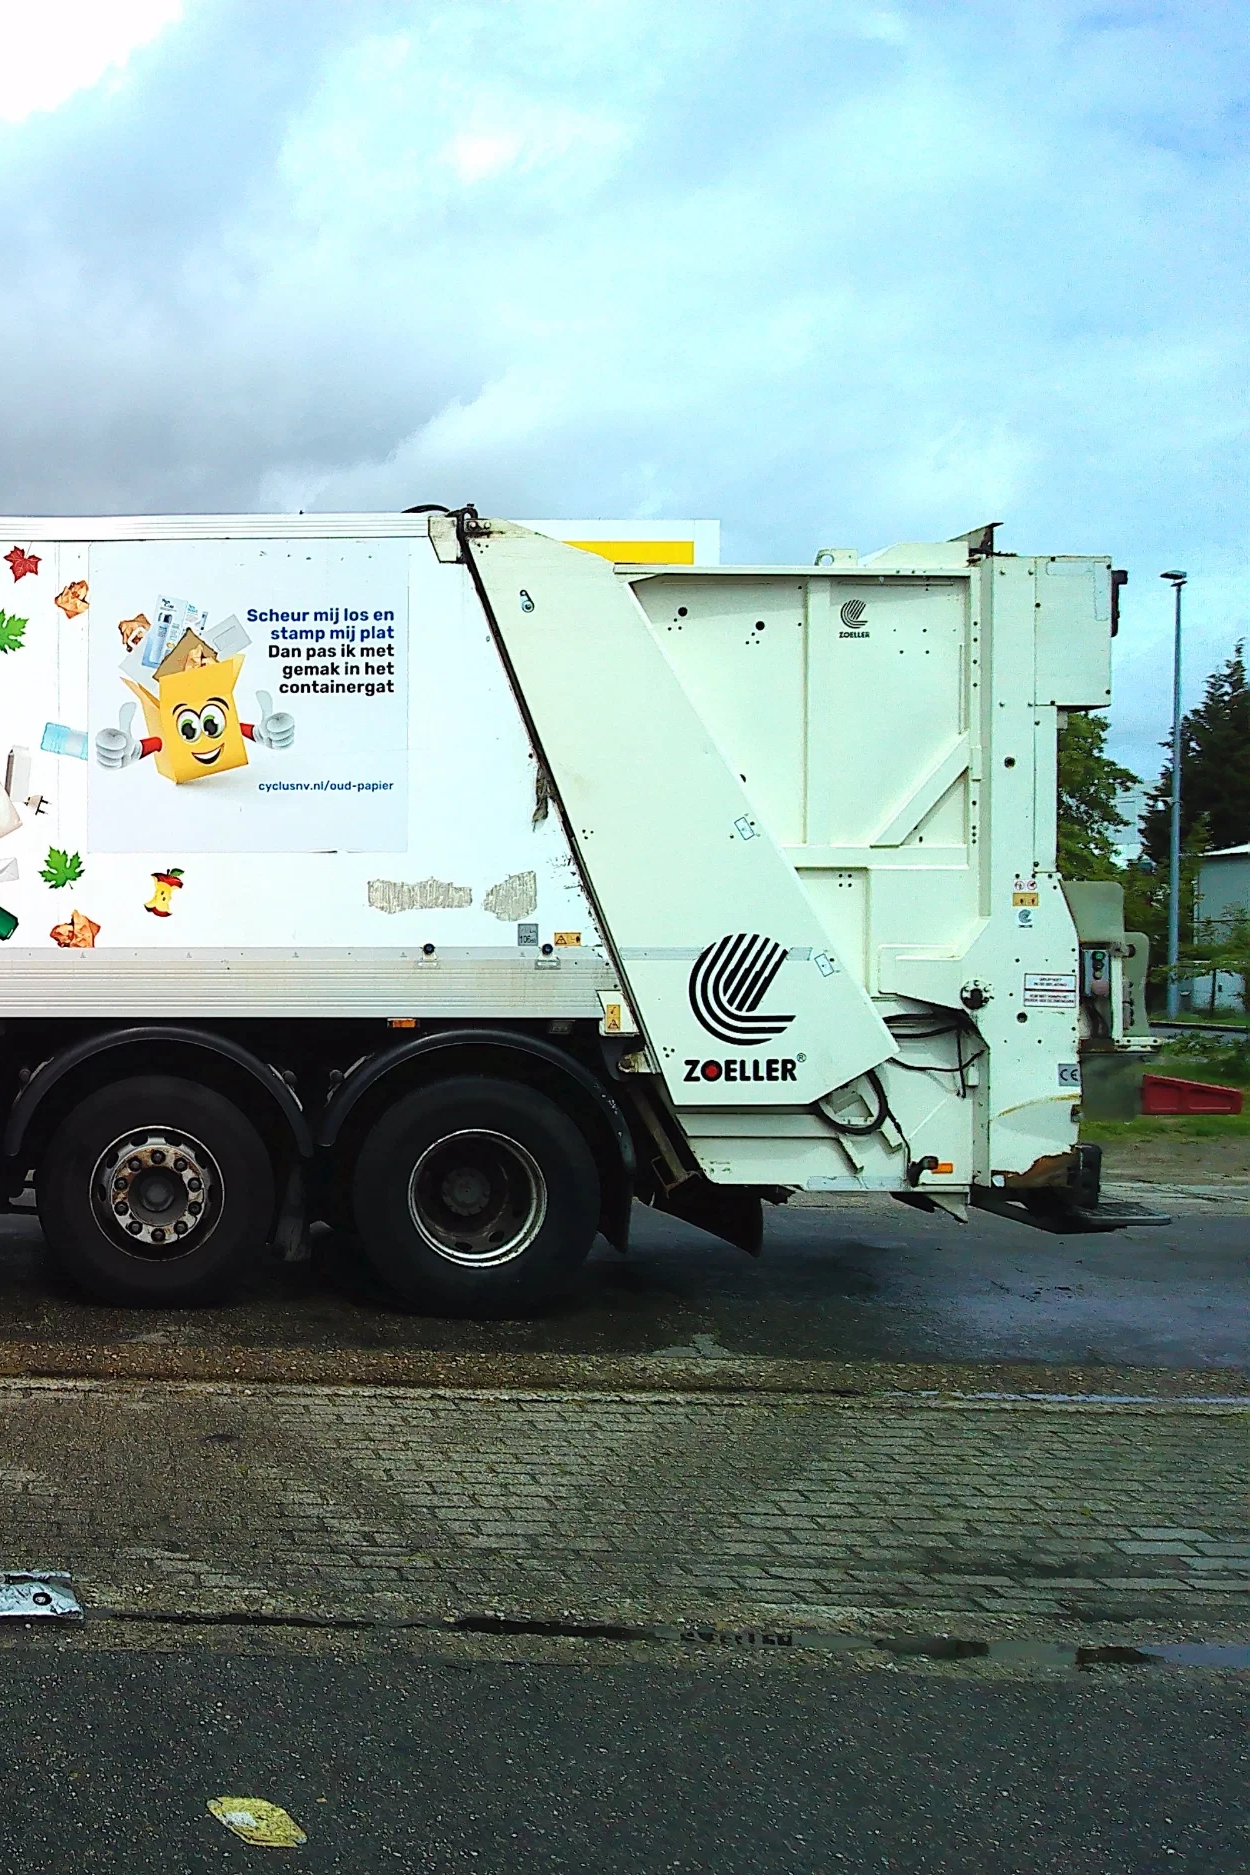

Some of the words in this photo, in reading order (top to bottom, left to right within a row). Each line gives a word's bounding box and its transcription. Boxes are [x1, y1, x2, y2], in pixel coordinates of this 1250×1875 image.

[247, 609, 310, 622] Scheur
[314, 608, 340, 624] mij
[344, 608, 369, 621] los
[373, 610, 394, 621] en
[270, 626, 325, 642] stamp
[330, 626, 355, 642] mij
[360, 626, 395, 642] plat
[839, 631, 870, 639] ZOELLER
[268, 644, 301, 658] Dan
[306, 647, 337, 660] pas
[341, 644, 356, 657] ik
[360, 643, 395, 657] met
[282, 662, 340, 679] gemak
[344, 662, 360, 675] in
[364, 662, 395, 675] het
[279, 680, 395, 696] containergat
[258, 780, 394, 792] cyclusnv.nl/oud-papier
[1060, 1068, 1078, 1081] CE
